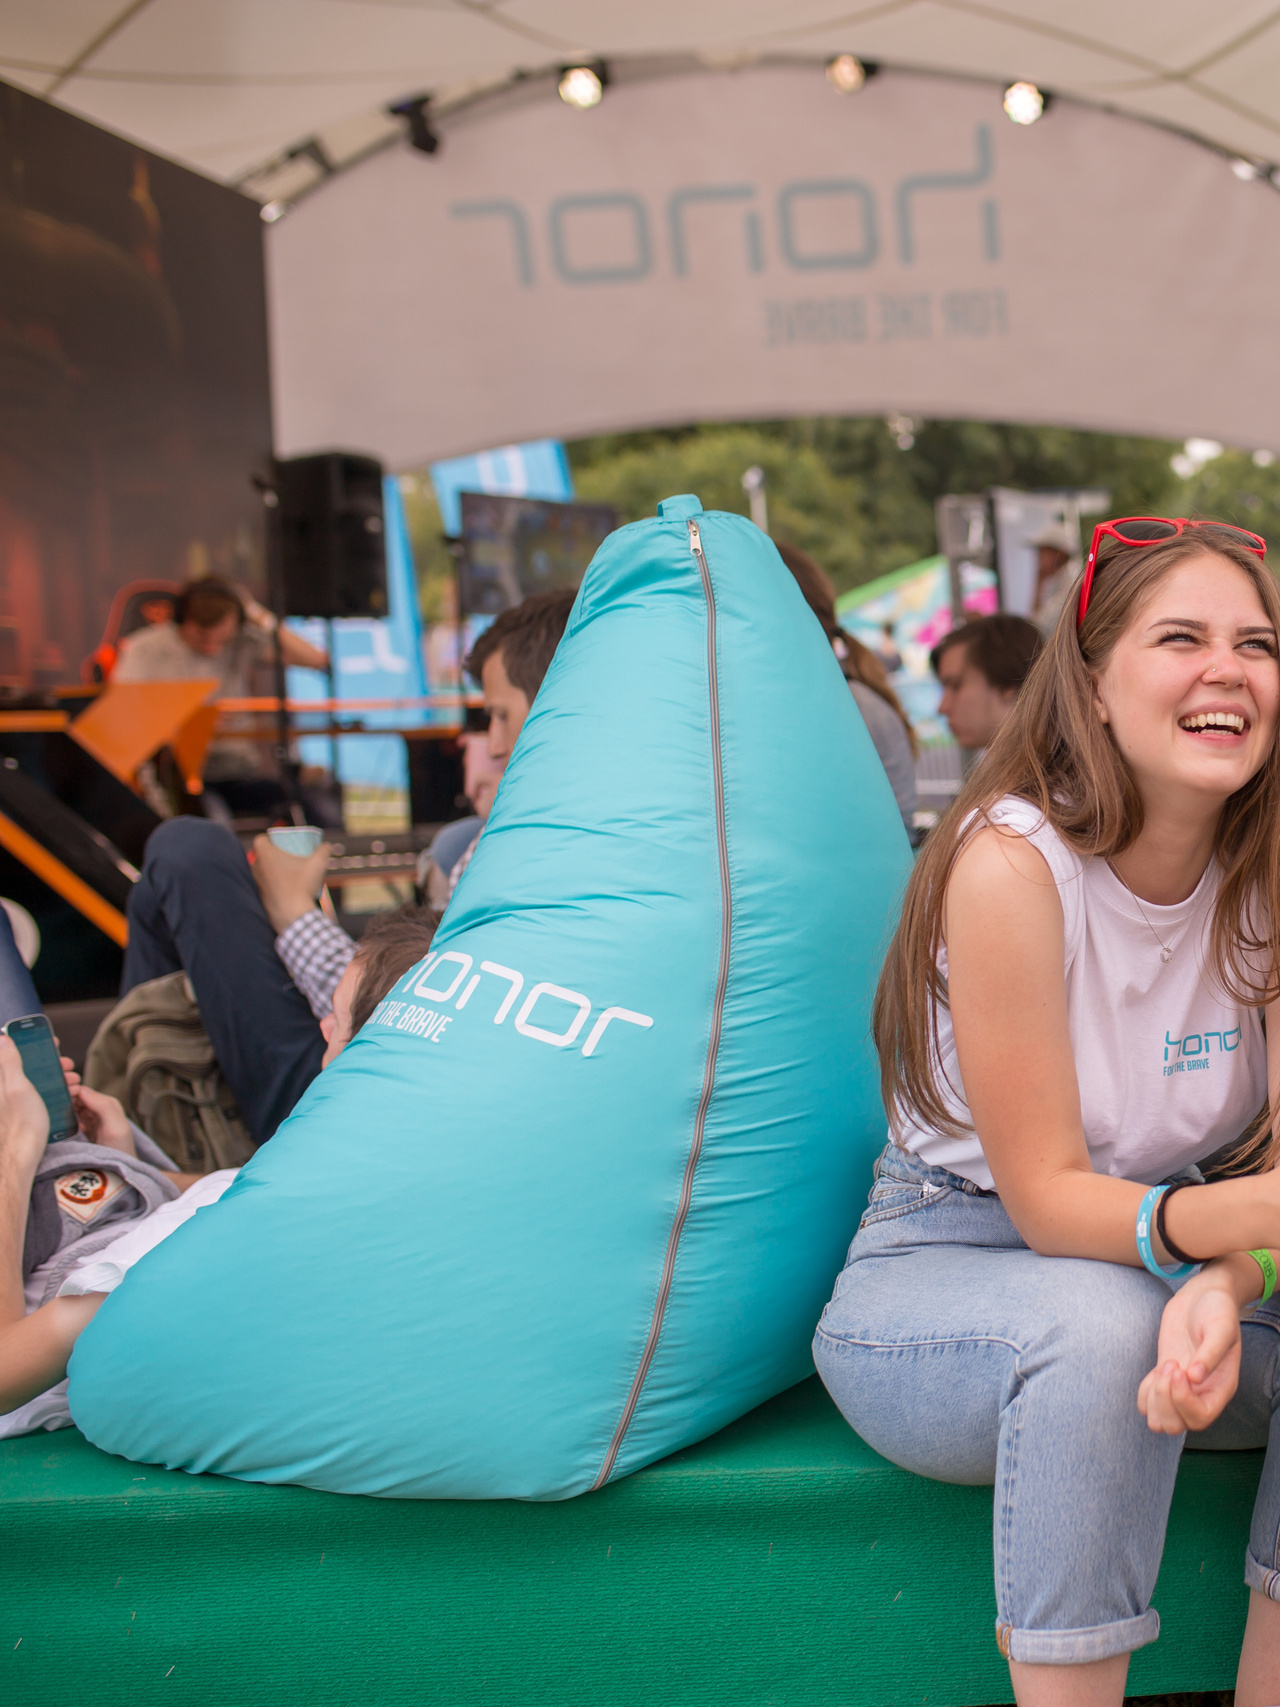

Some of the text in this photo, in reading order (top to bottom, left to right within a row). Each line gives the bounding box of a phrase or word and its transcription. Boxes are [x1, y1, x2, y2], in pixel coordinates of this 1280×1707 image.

[377, 1001, 406, 1027] THE
[396, 1004, 453, 1043] BRAVE
[1187, 1058, 1210, 1071] BRAVE
